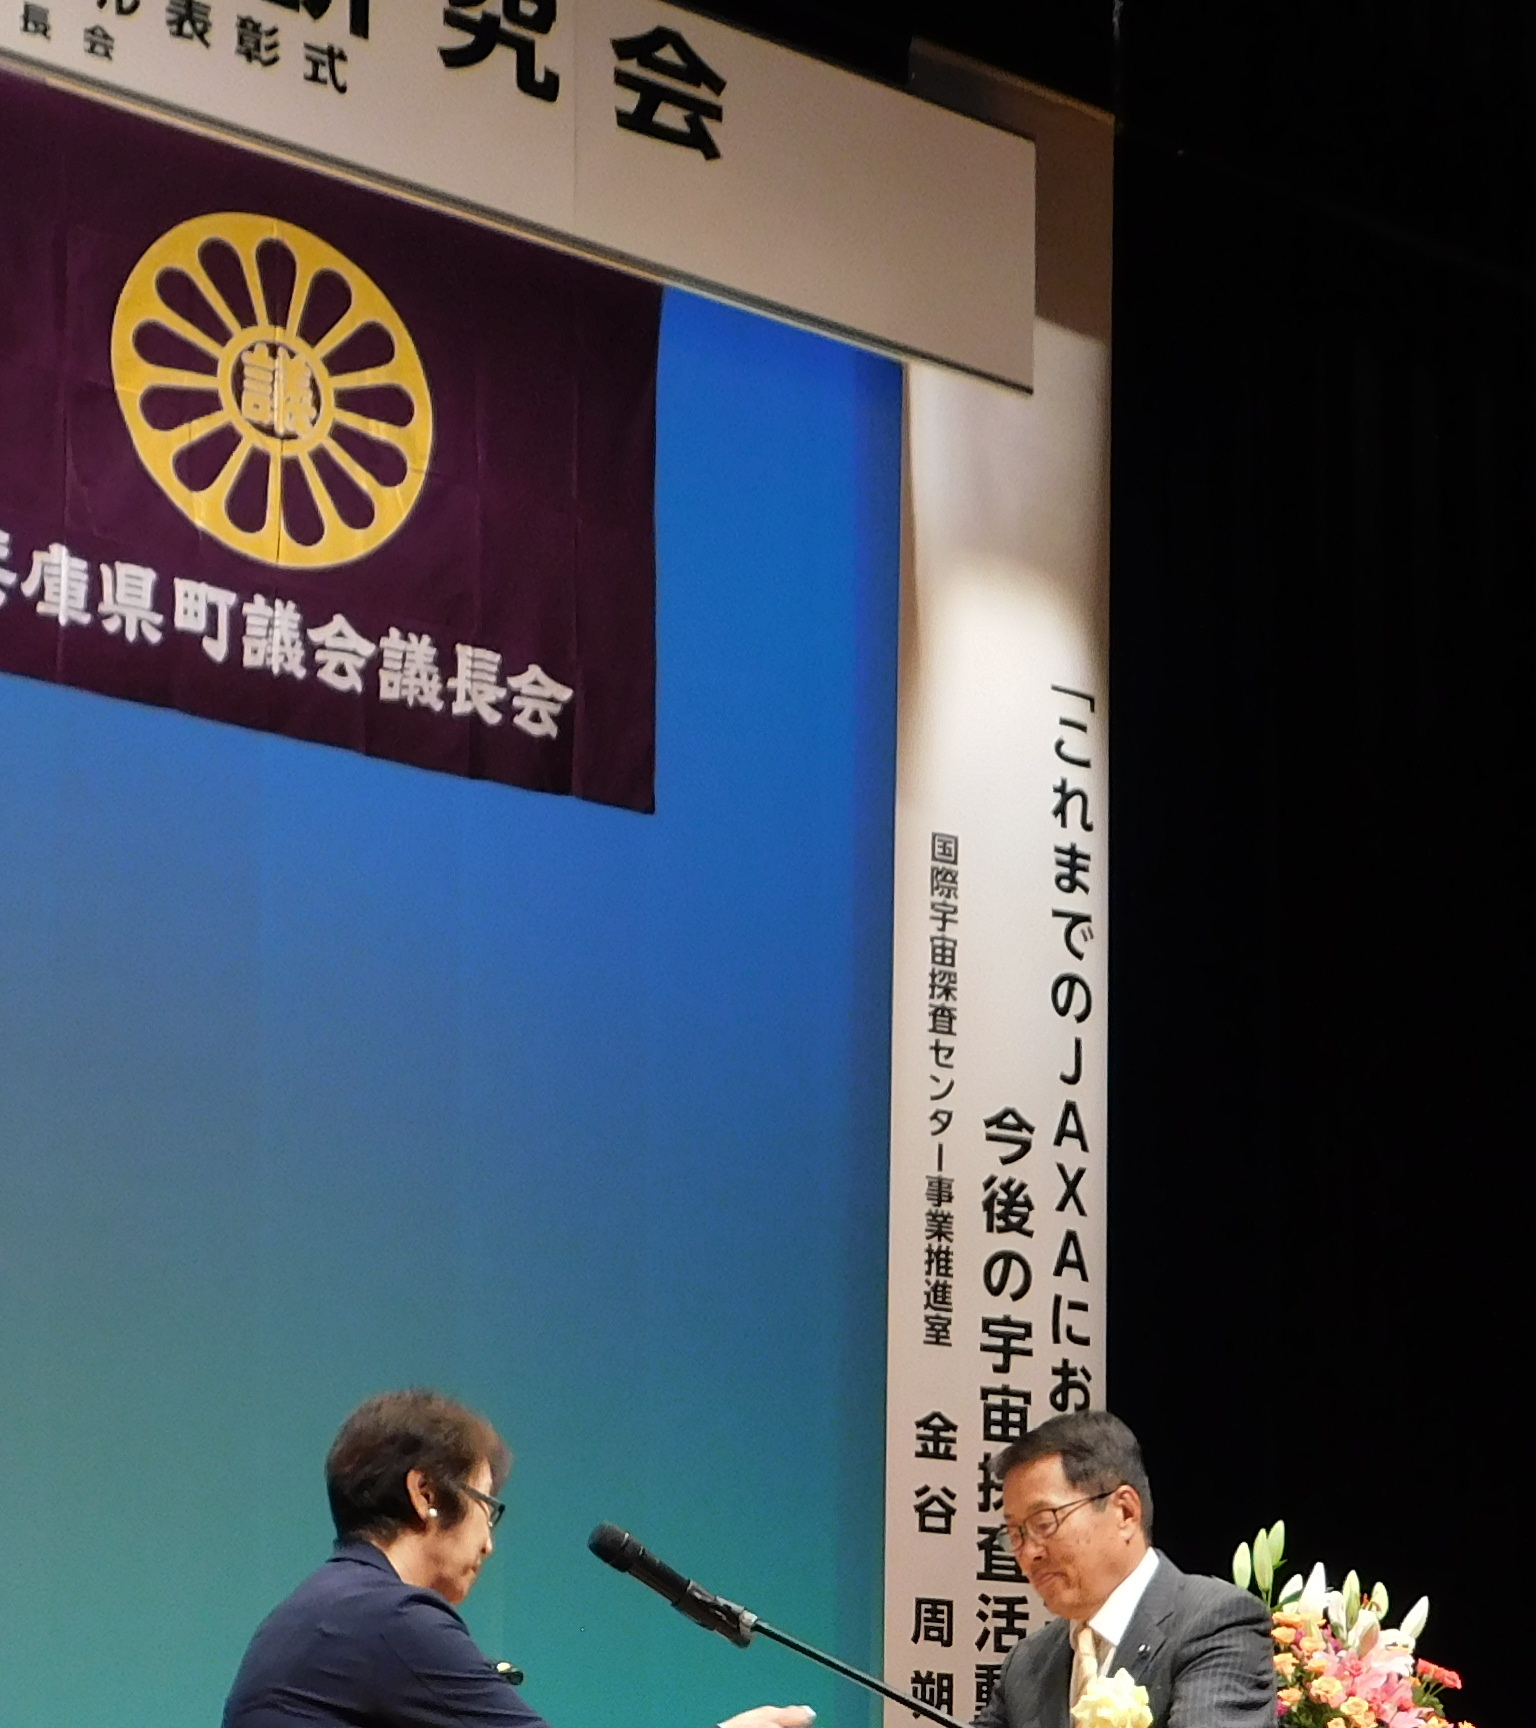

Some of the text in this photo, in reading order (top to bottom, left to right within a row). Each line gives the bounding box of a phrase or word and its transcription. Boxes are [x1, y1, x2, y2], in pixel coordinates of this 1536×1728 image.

[261, 0, 728, 162] 究会
[922, 831, 960, 1348] 国際宇宙探査センター事業推進室
